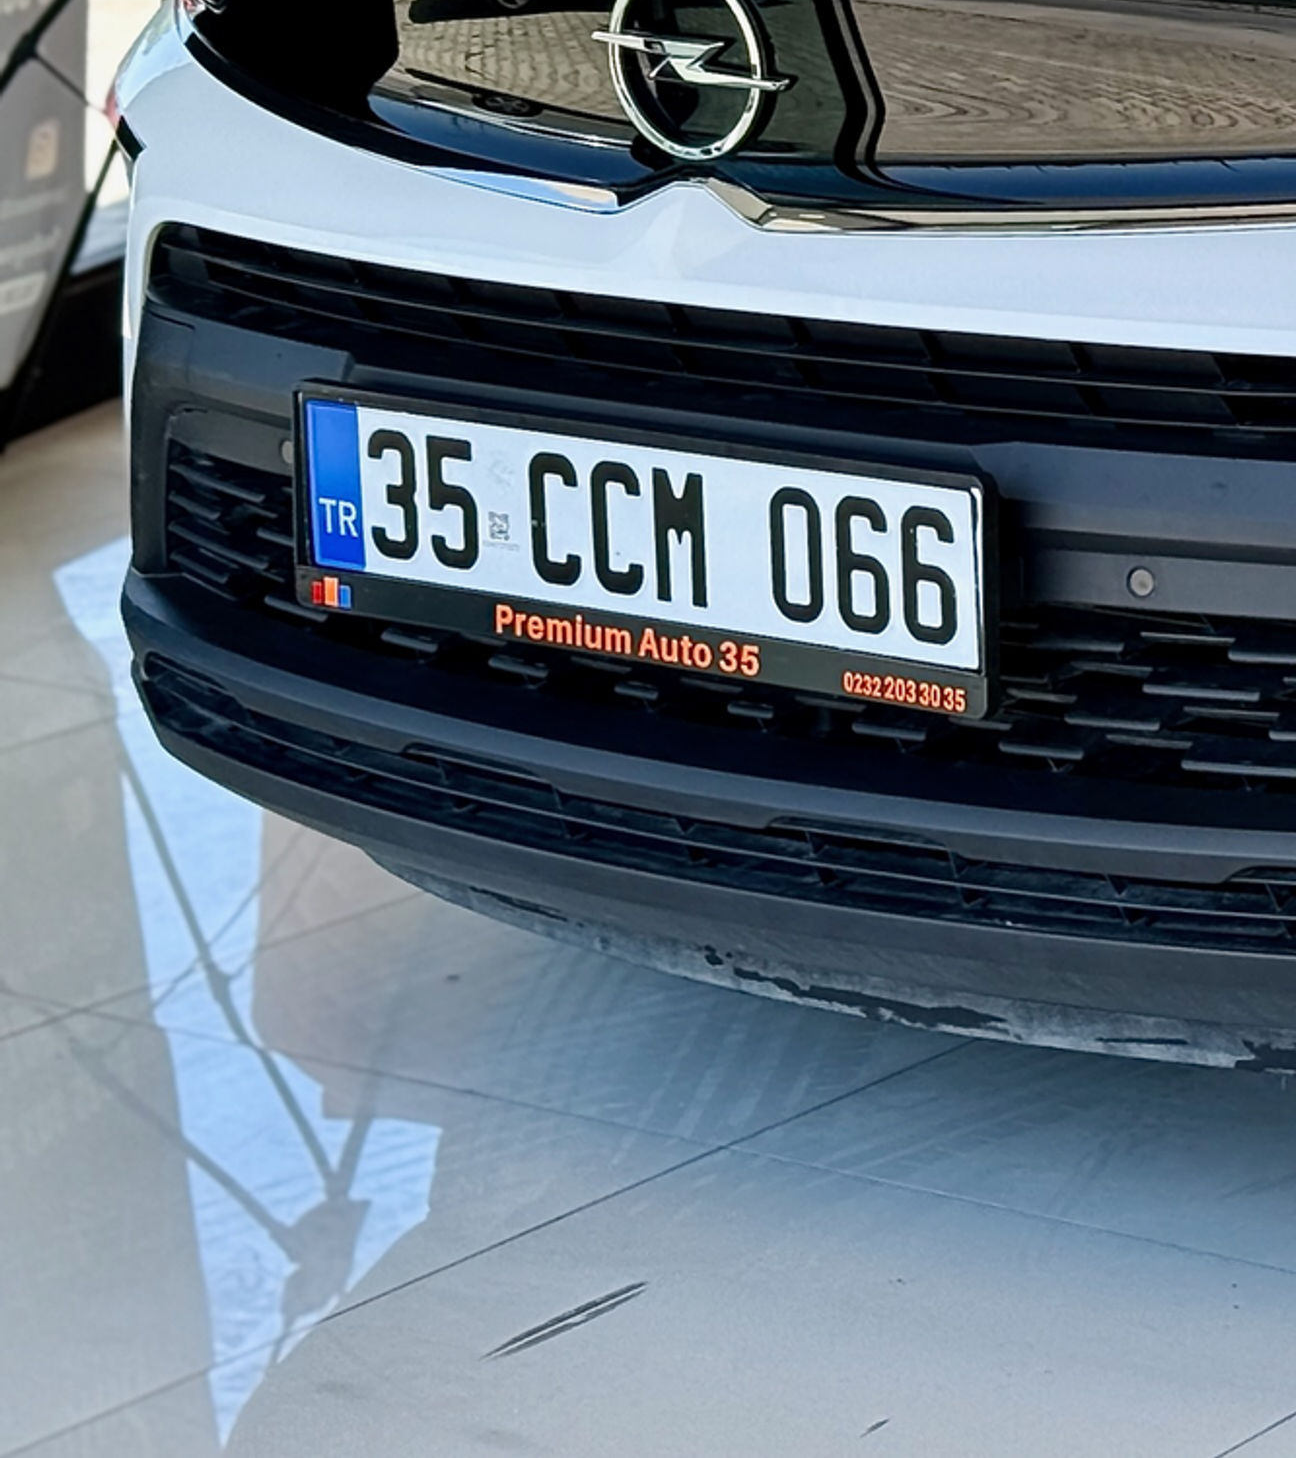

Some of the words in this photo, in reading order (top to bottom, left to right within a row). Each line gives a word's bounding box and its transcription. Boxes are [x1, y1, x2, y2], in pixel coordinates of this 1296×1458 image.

[318, 497, 358, 538] TR
[367, 428, 480, 571] 35
[528, 451, 709, 609] CCM
[769, 486, 958, 646] 066
[494, 603, 632, 655] Premium
[637, 627, 713, 669] Auto
[718, 640, 761, 677] 35
